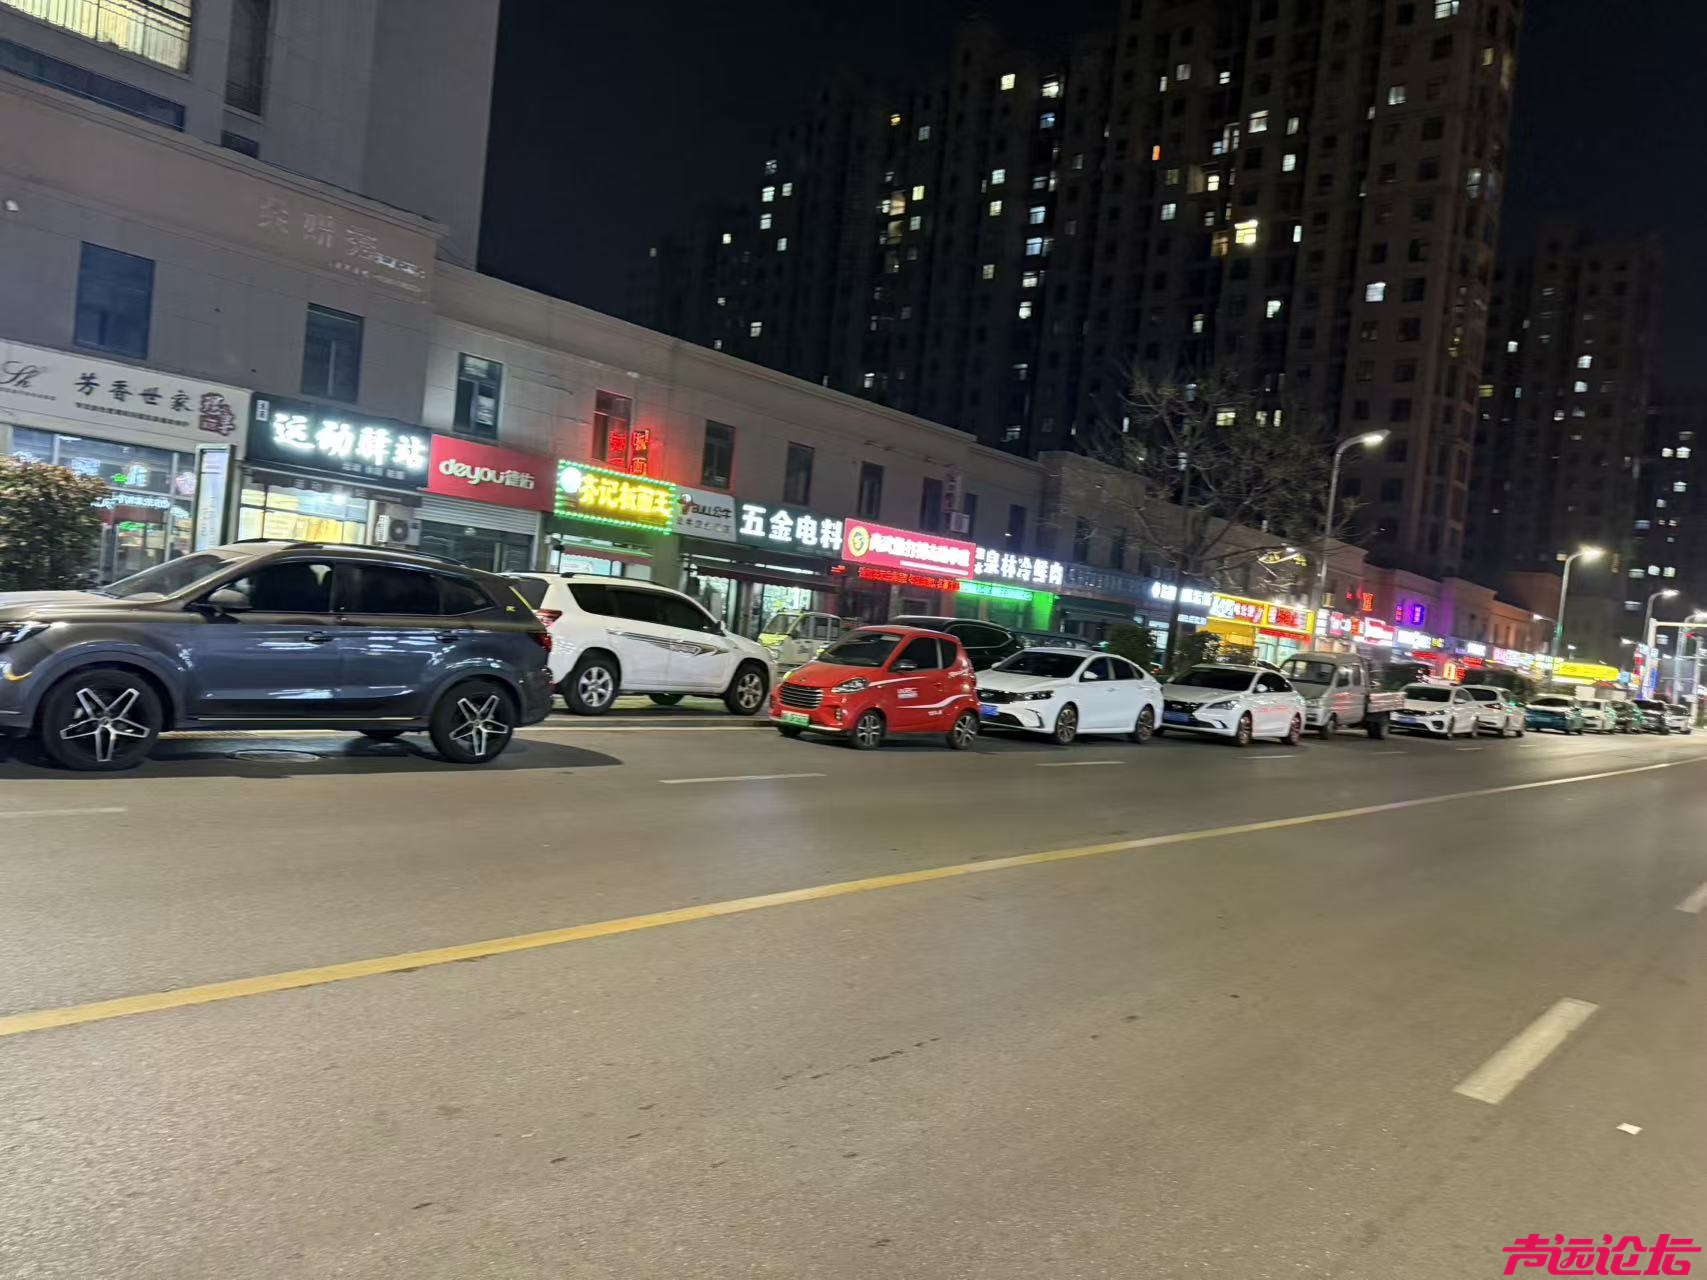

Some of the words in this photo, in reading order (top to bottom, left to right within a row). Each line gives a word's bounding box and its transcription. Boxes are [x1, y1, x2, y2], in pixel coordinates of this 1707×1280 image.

[74, 372, 195, 412] 芳香世家
[272, 412, 428, 467] 运动驿站
[439, 458, 504, 486] deyou
[739, 502, 843, 551] 五金电料
